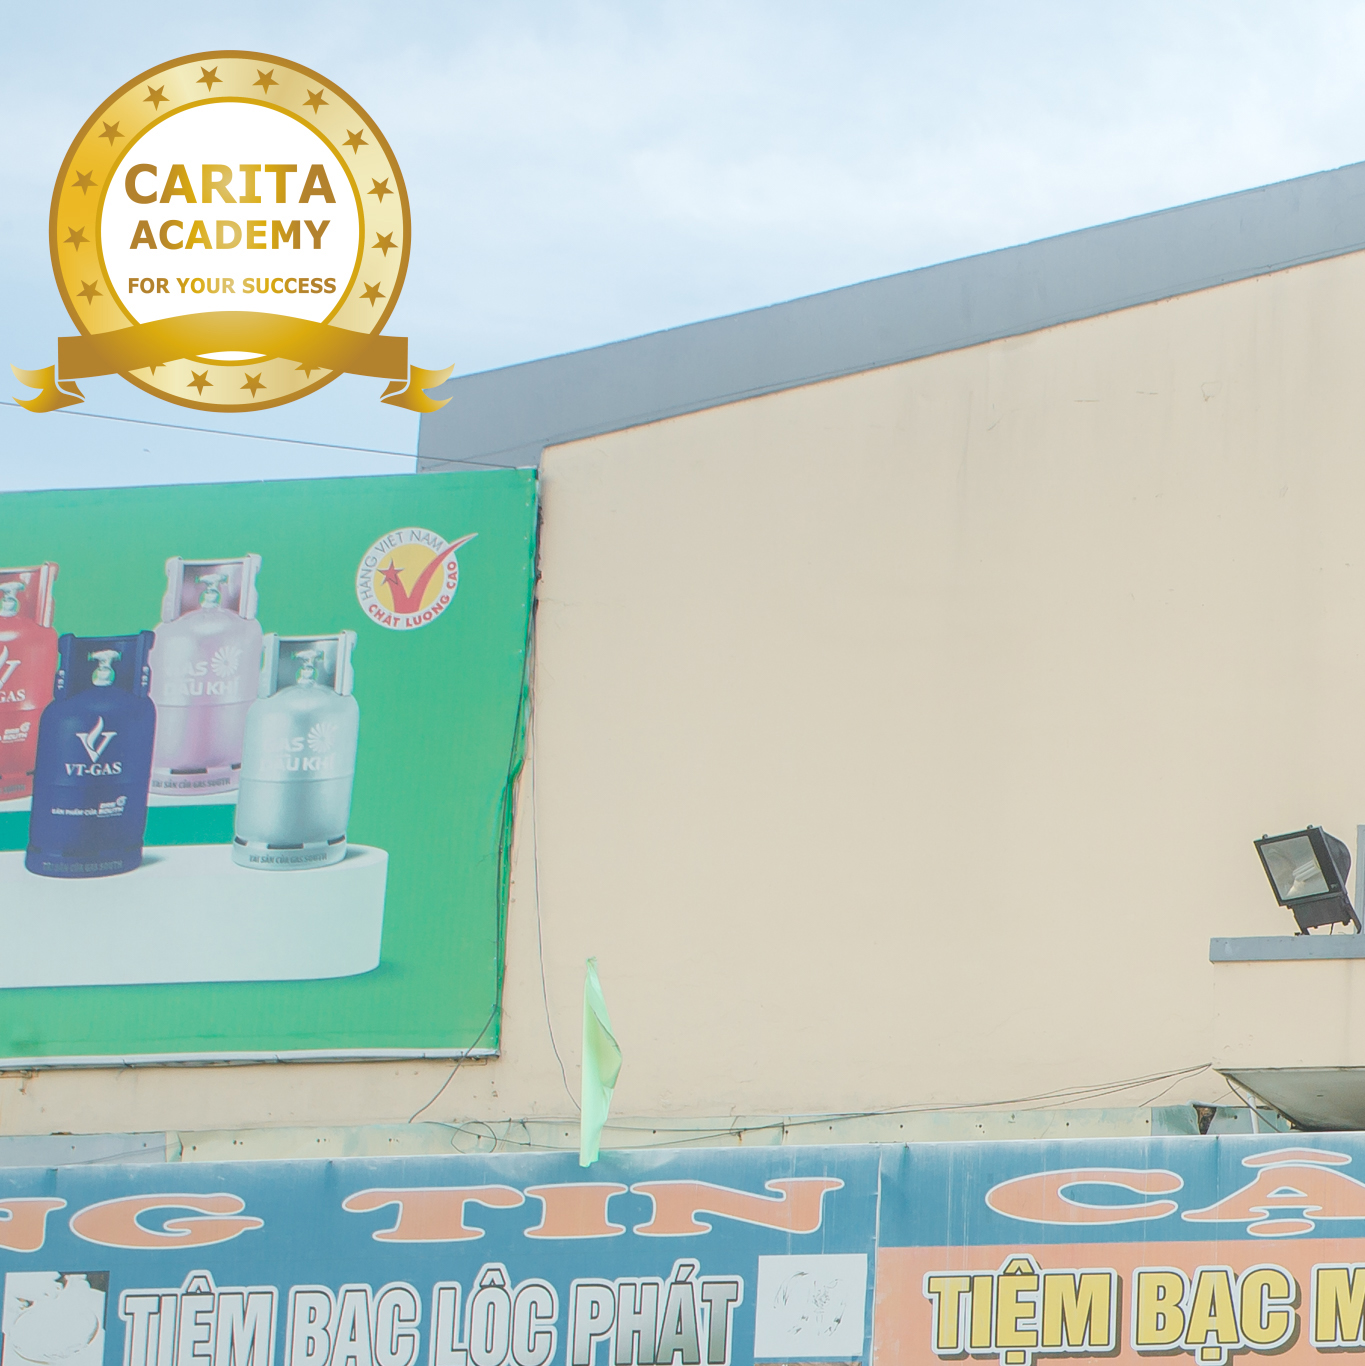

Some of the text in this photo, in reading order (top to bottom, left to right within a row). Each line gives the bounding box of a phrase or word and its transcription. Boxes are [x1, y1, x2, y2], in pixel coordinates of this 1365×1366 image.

[410, 530, 444, 551] NAM
[65, 762, 123, 776] VT-GAS
[341, 1177, 845, 1244] TIN
